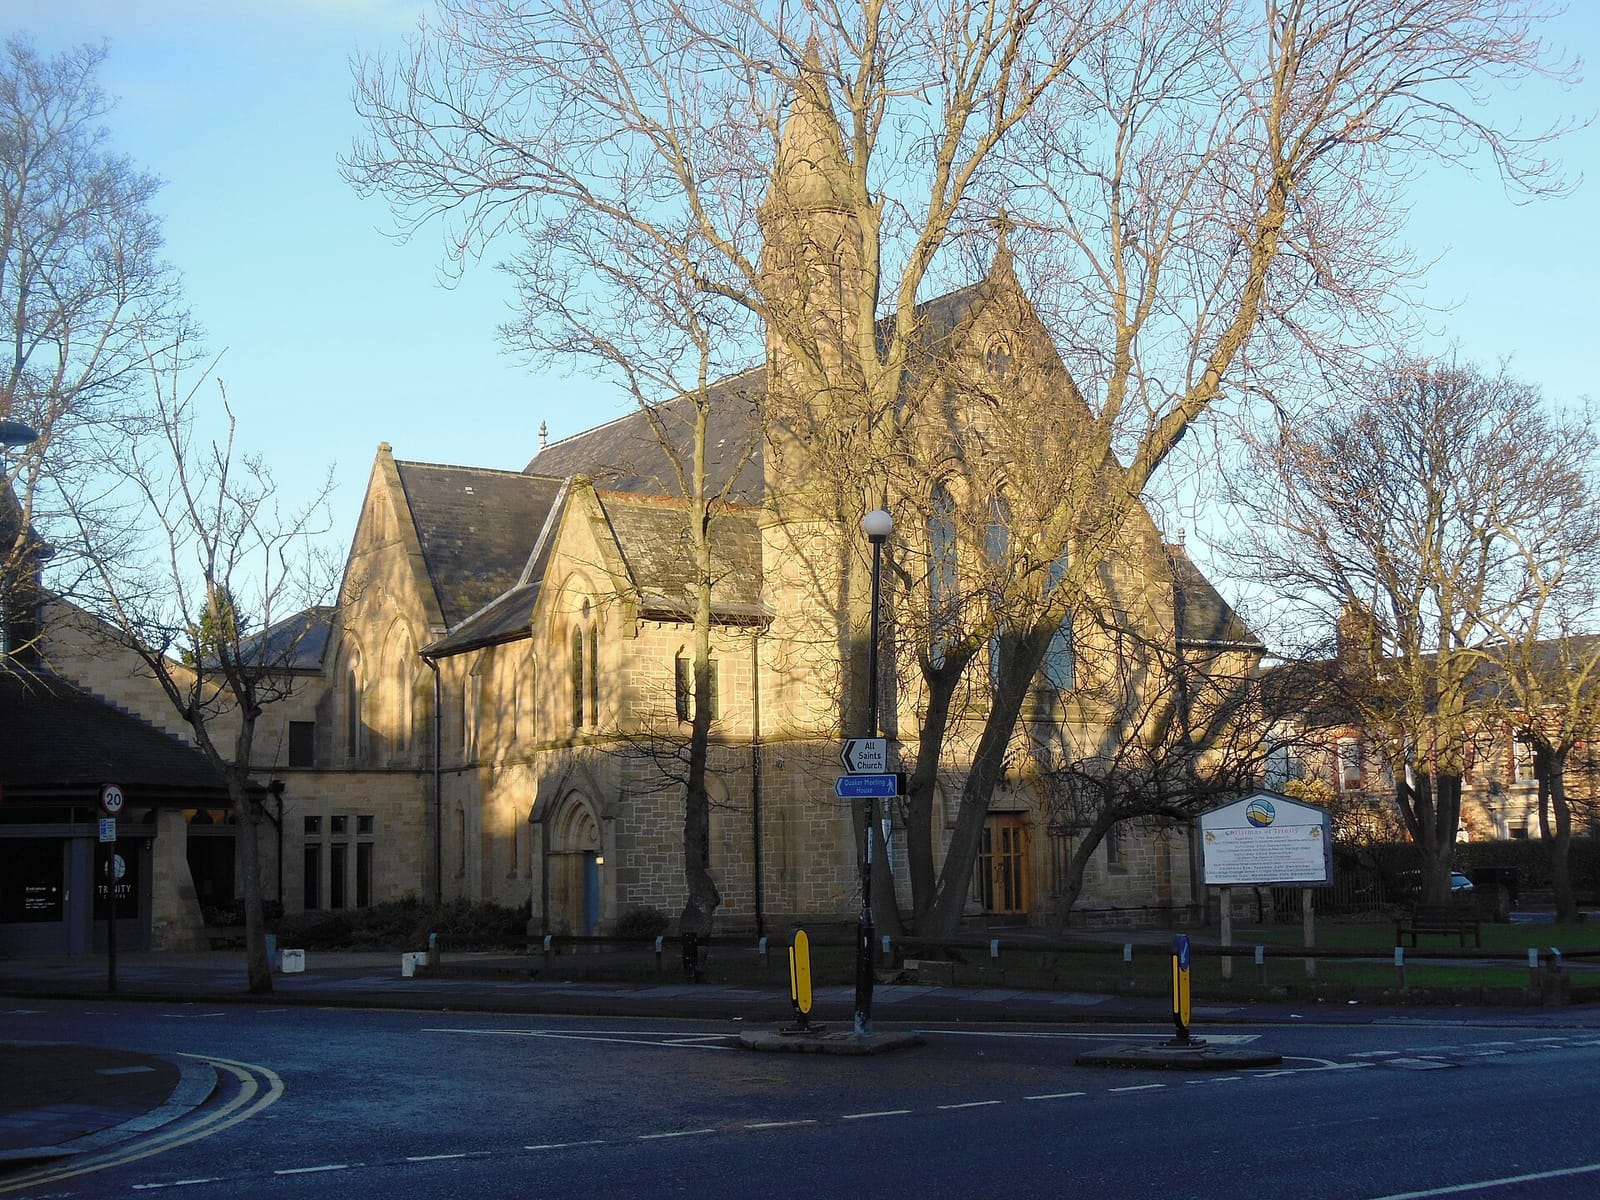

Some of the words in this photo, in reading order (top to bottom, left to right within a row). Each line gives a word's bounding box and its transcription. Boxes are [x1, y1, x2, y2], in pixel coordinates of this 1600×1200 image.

[865, 742, 874, 750] All
[858, 752, 881, 760] Saints
[844, 779, 863, 787] Quaker
[864, 779, 886, 787] Meeting
[106, 793, 121, 806] 20
